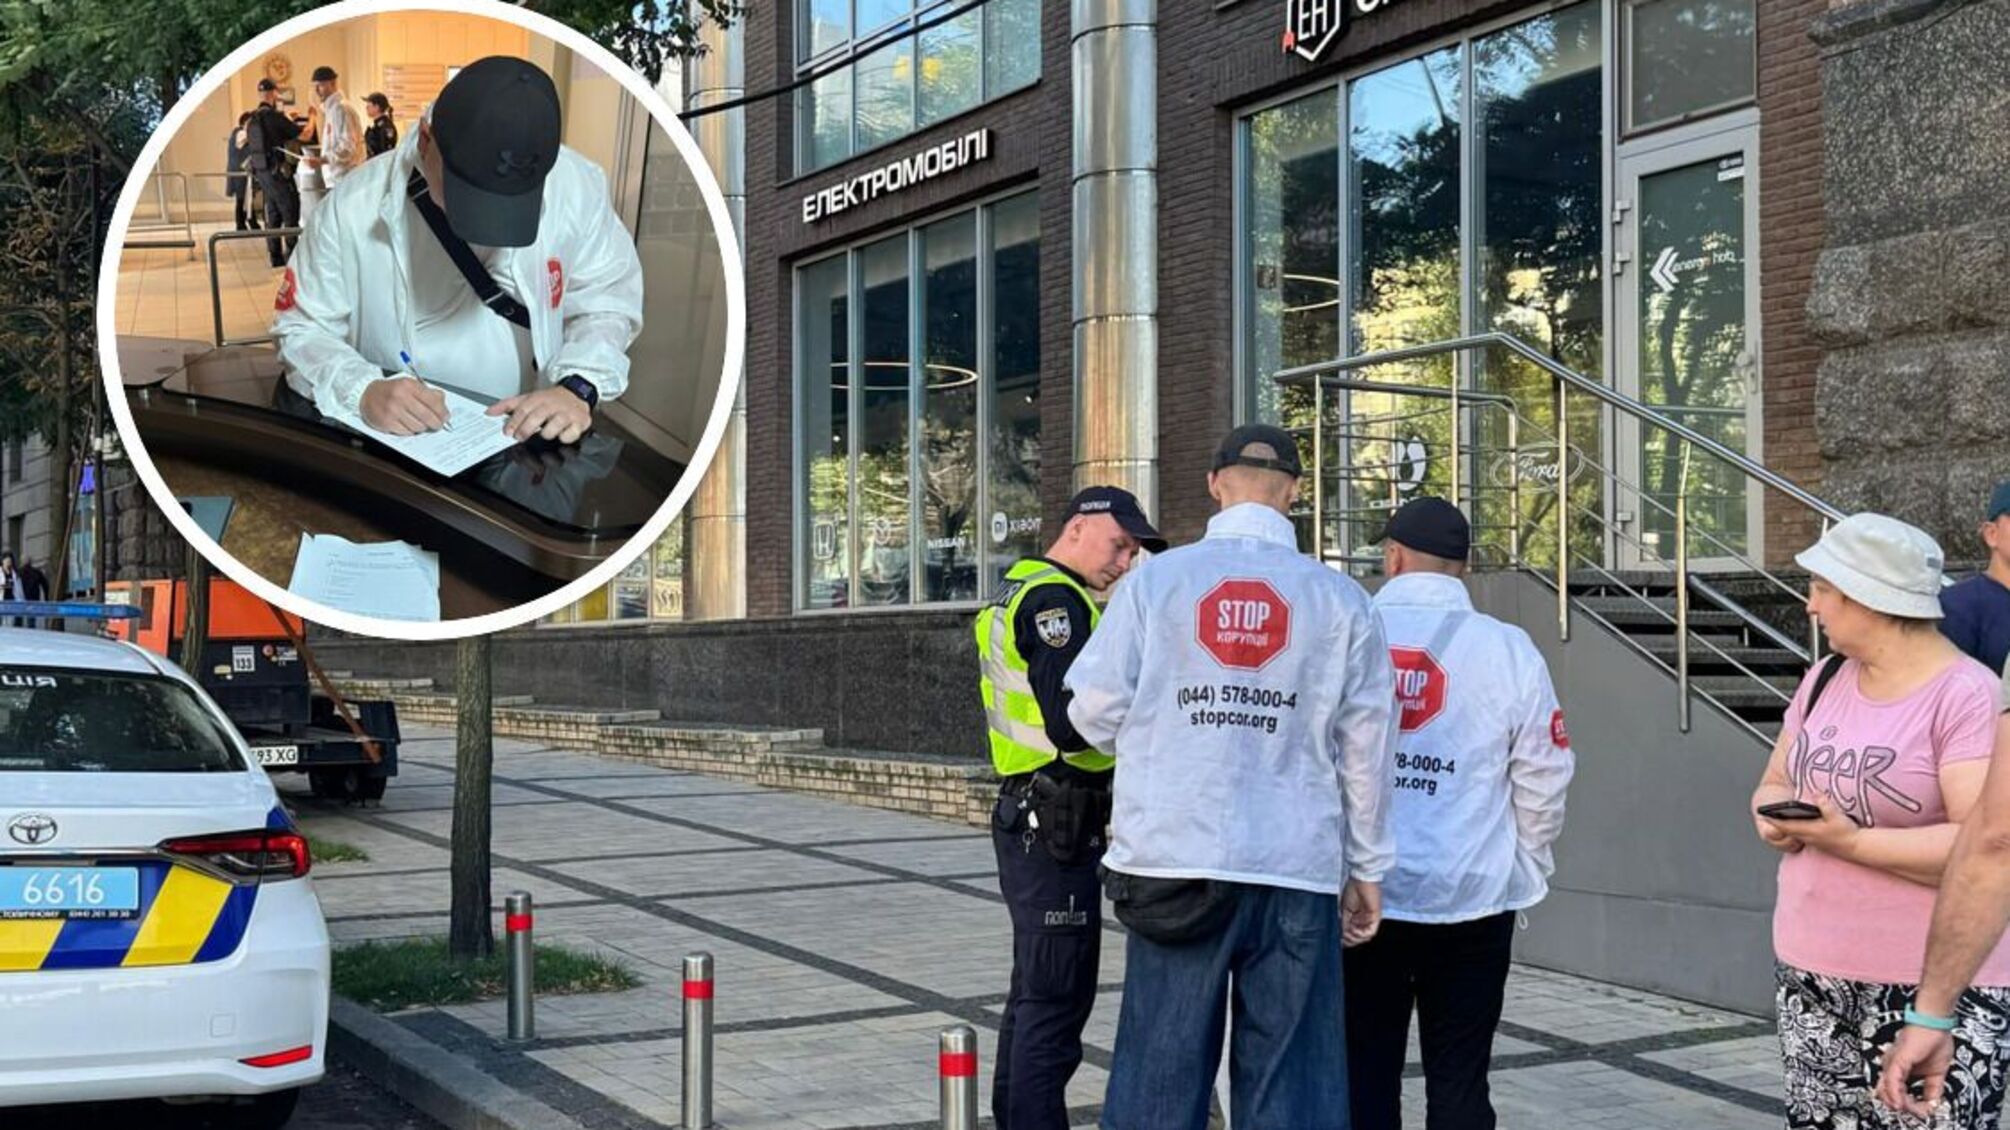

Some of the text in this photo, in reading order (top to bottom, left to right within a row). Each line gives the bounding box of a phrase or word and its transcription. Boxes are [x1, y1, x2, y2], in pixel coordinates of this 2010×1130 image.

[803, 128, 988, 223] ЕЛЕКТРОМОБІЛІ
[1218, 600, 1271, 631] STOP
[1178, 684, 1298, 710] (044) 578-000-4
[1191, 708, 1278, 733] stopcor.org
[276, 748, 296, 763] XG
[24, 872, 104, 904] 6616
